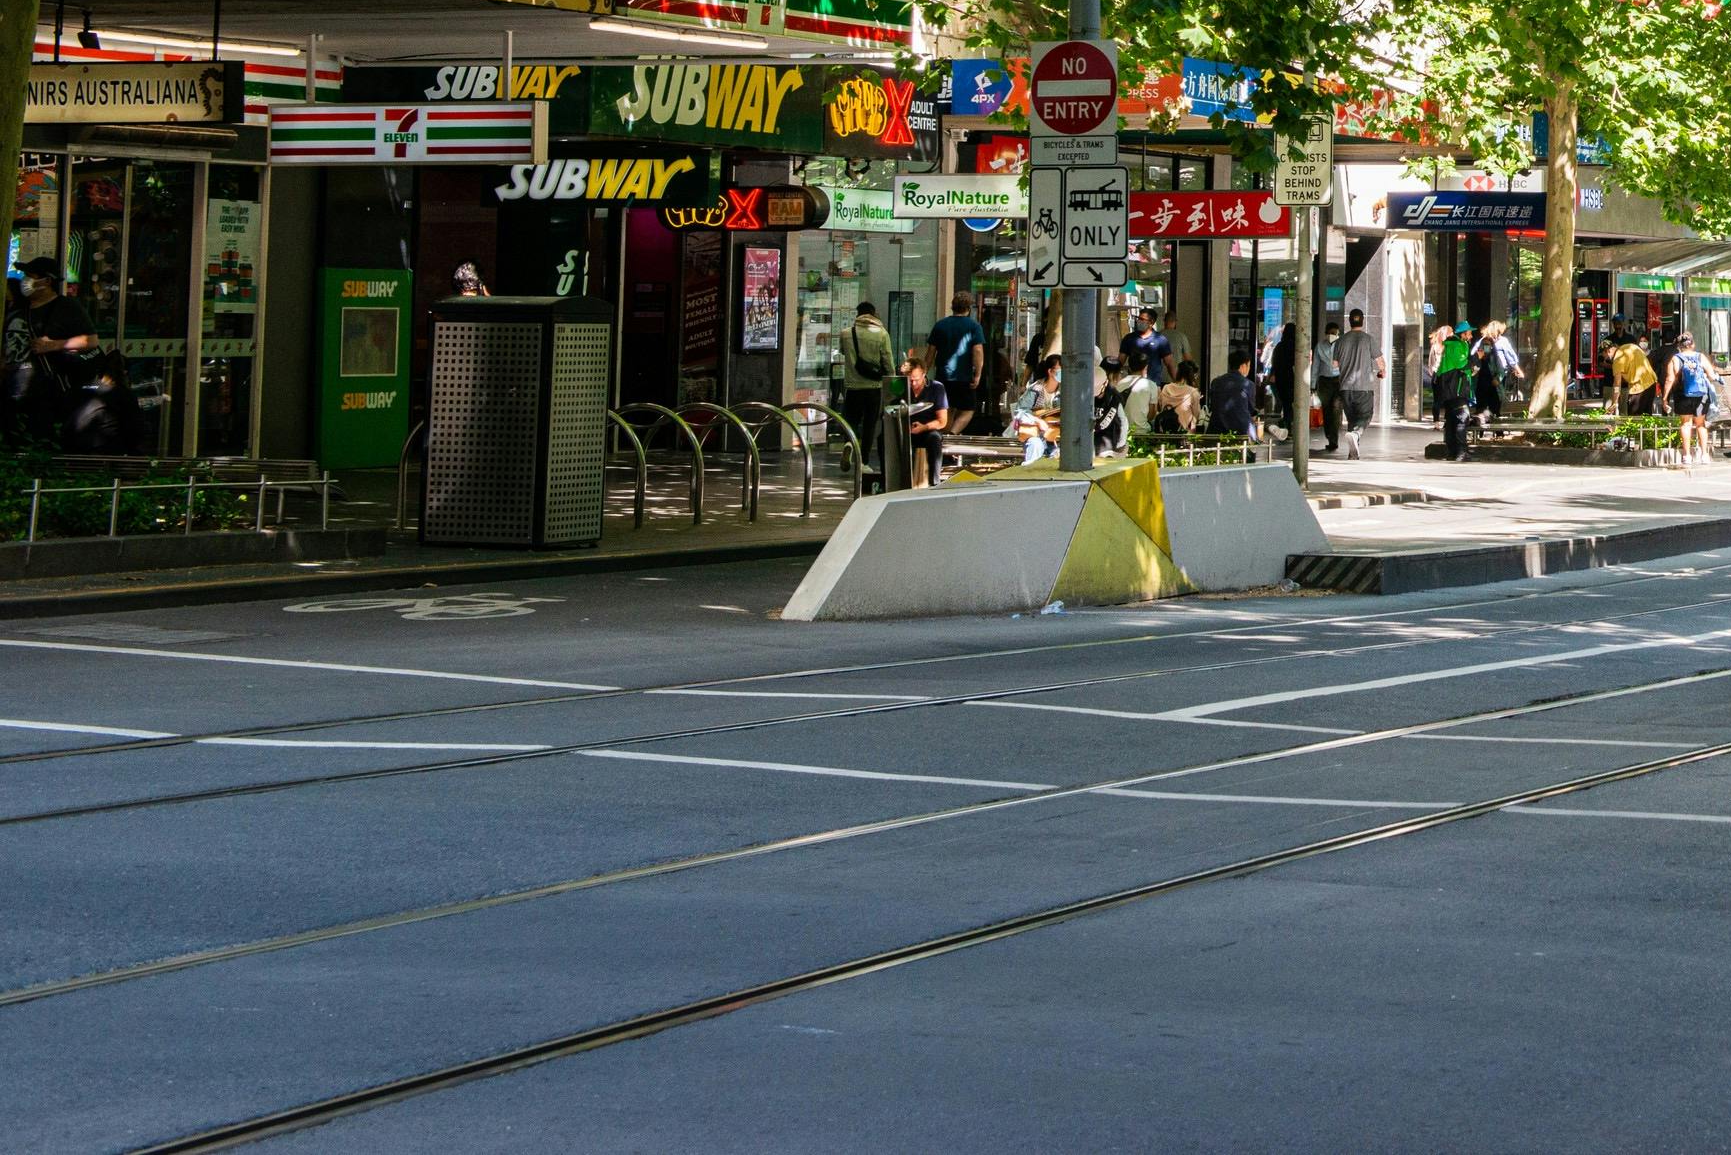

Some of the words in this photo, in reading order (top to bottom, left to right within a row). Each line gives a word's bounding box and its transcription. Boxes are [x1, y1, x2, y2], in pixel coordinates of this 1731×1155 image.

[1062, 56, 1087, 76] NO
[74, 78, 199, 106] AUSTRALIANA
[424, 64, 582, 102] SUBWAY
[615, 54, 804, 135] SUBWAY
[970, 93, 997, 105] 4PX
[883, 77, 915, 145] X
[910, 100, 934, 115] ADULT
[1043, 101, 1103, 120] ENTRY
[907, 115, 937, 131] CENTRE
[1043, 141, 1075, 149] BICYCLES
[1082, 140, 1105, 148] TRAMS
[1057, 152, 1089, 161] EXCEPTED
[495, 154, 697, 203] SUBWAY
[1291, 165, 1316, 176] STOP
[1284, 178, 1322, 188] BEHIND
[903, 189, 1009, 210] RoyalNature
[1286, 191, 1320, 200] TRAMS
[1584, 189, 1604, 209] HSBC
[969, 205, 1009, 214] Australia
[1070, 224, 1121, 247] ONLY
[341, 280, 398, 298] SUBWAY
[340, 391, 397, 410] SUBWAY
